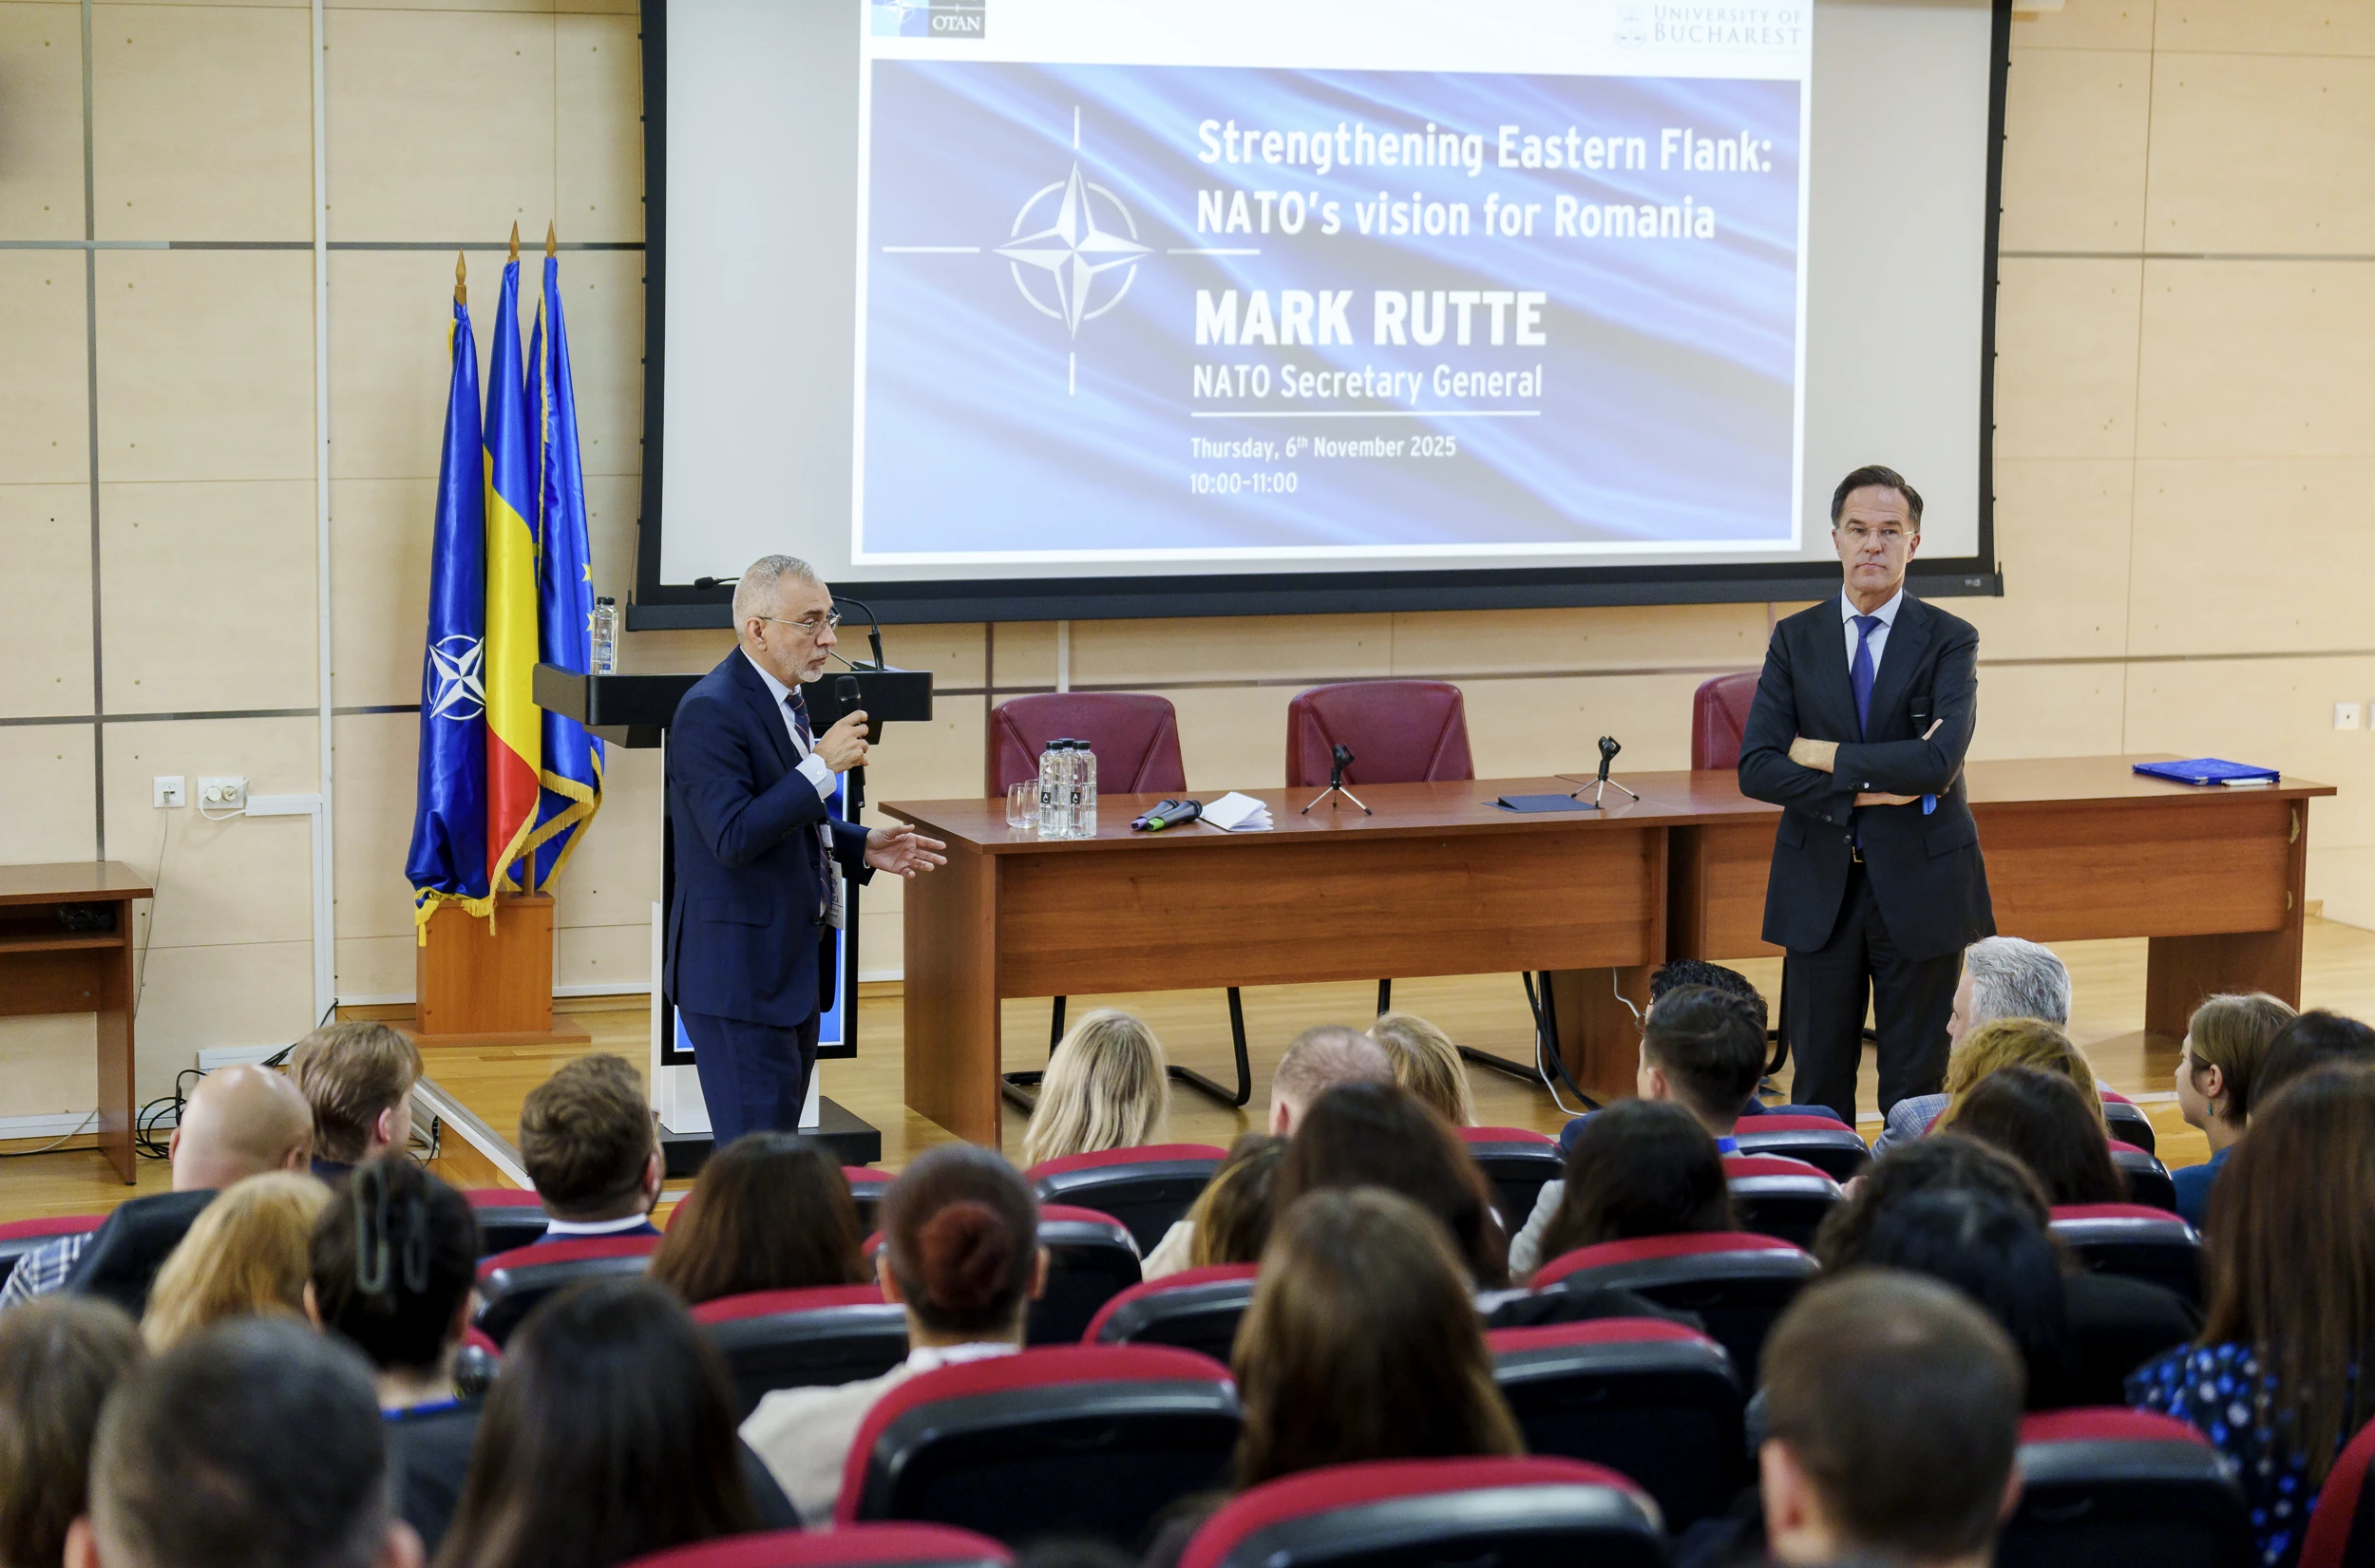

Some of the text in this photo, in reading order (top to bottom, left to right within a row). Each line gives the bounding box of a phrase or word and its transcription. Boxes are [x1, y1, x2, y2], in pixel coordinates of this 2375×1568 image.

[932, 15, 980, 31] OTAN
[1654, 5, 1802, 24] UNIVERSITY OF
[1654, 22, 1802, 46] BUCHAREST
[1198, 119, 1773, 178] Strengthening Eastern Flank:
[1197, 189, 1716, 239] NATO's vision for Romania
[1195, 289, 1548, 347] MARK RUTTE
[1193, 364, 1543, 405] NATO Secretary General
[1190, 434, 1457, 463] Thursday, 6th November 2025
